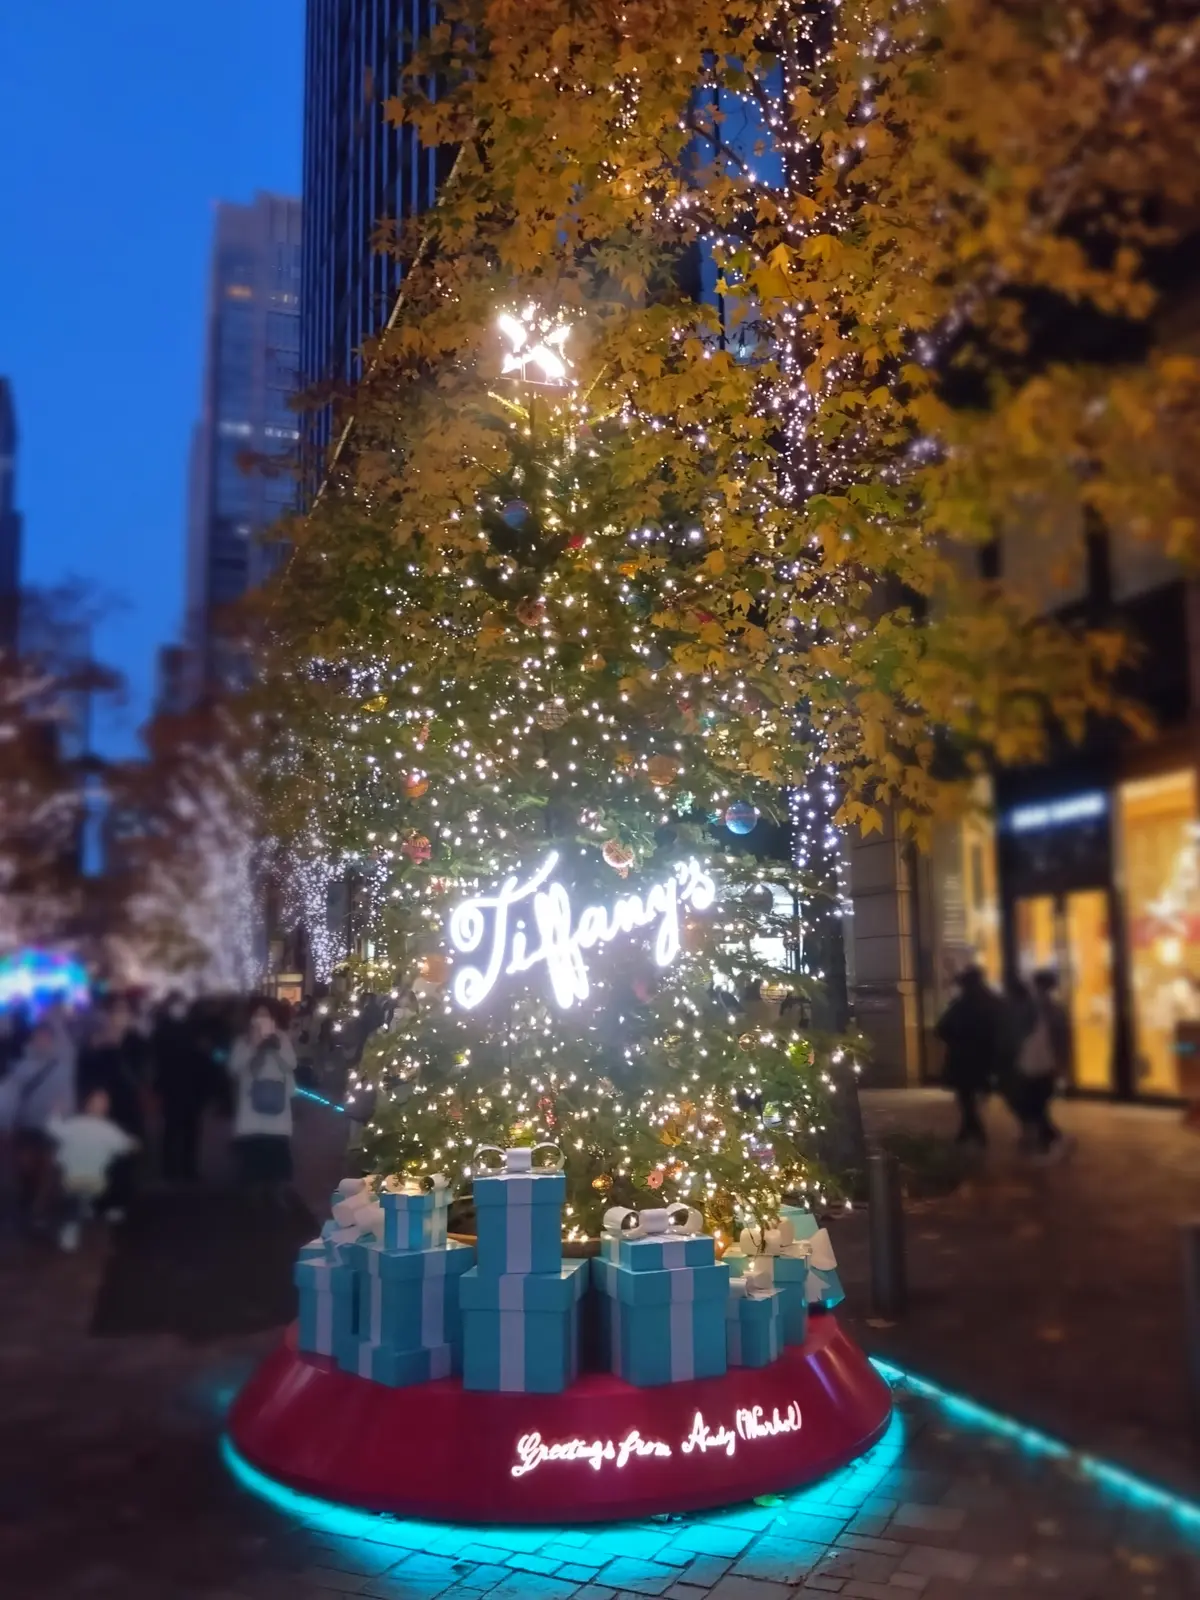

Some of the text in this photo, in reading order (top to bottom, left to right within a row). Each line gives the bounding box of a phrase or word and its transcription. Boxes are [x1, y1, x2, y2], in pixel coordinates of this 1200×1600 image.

[450, 851, 715, 1010] Tiffany's
[511, 1400, 802, 1477] Greetings from Andy (Warhol)
